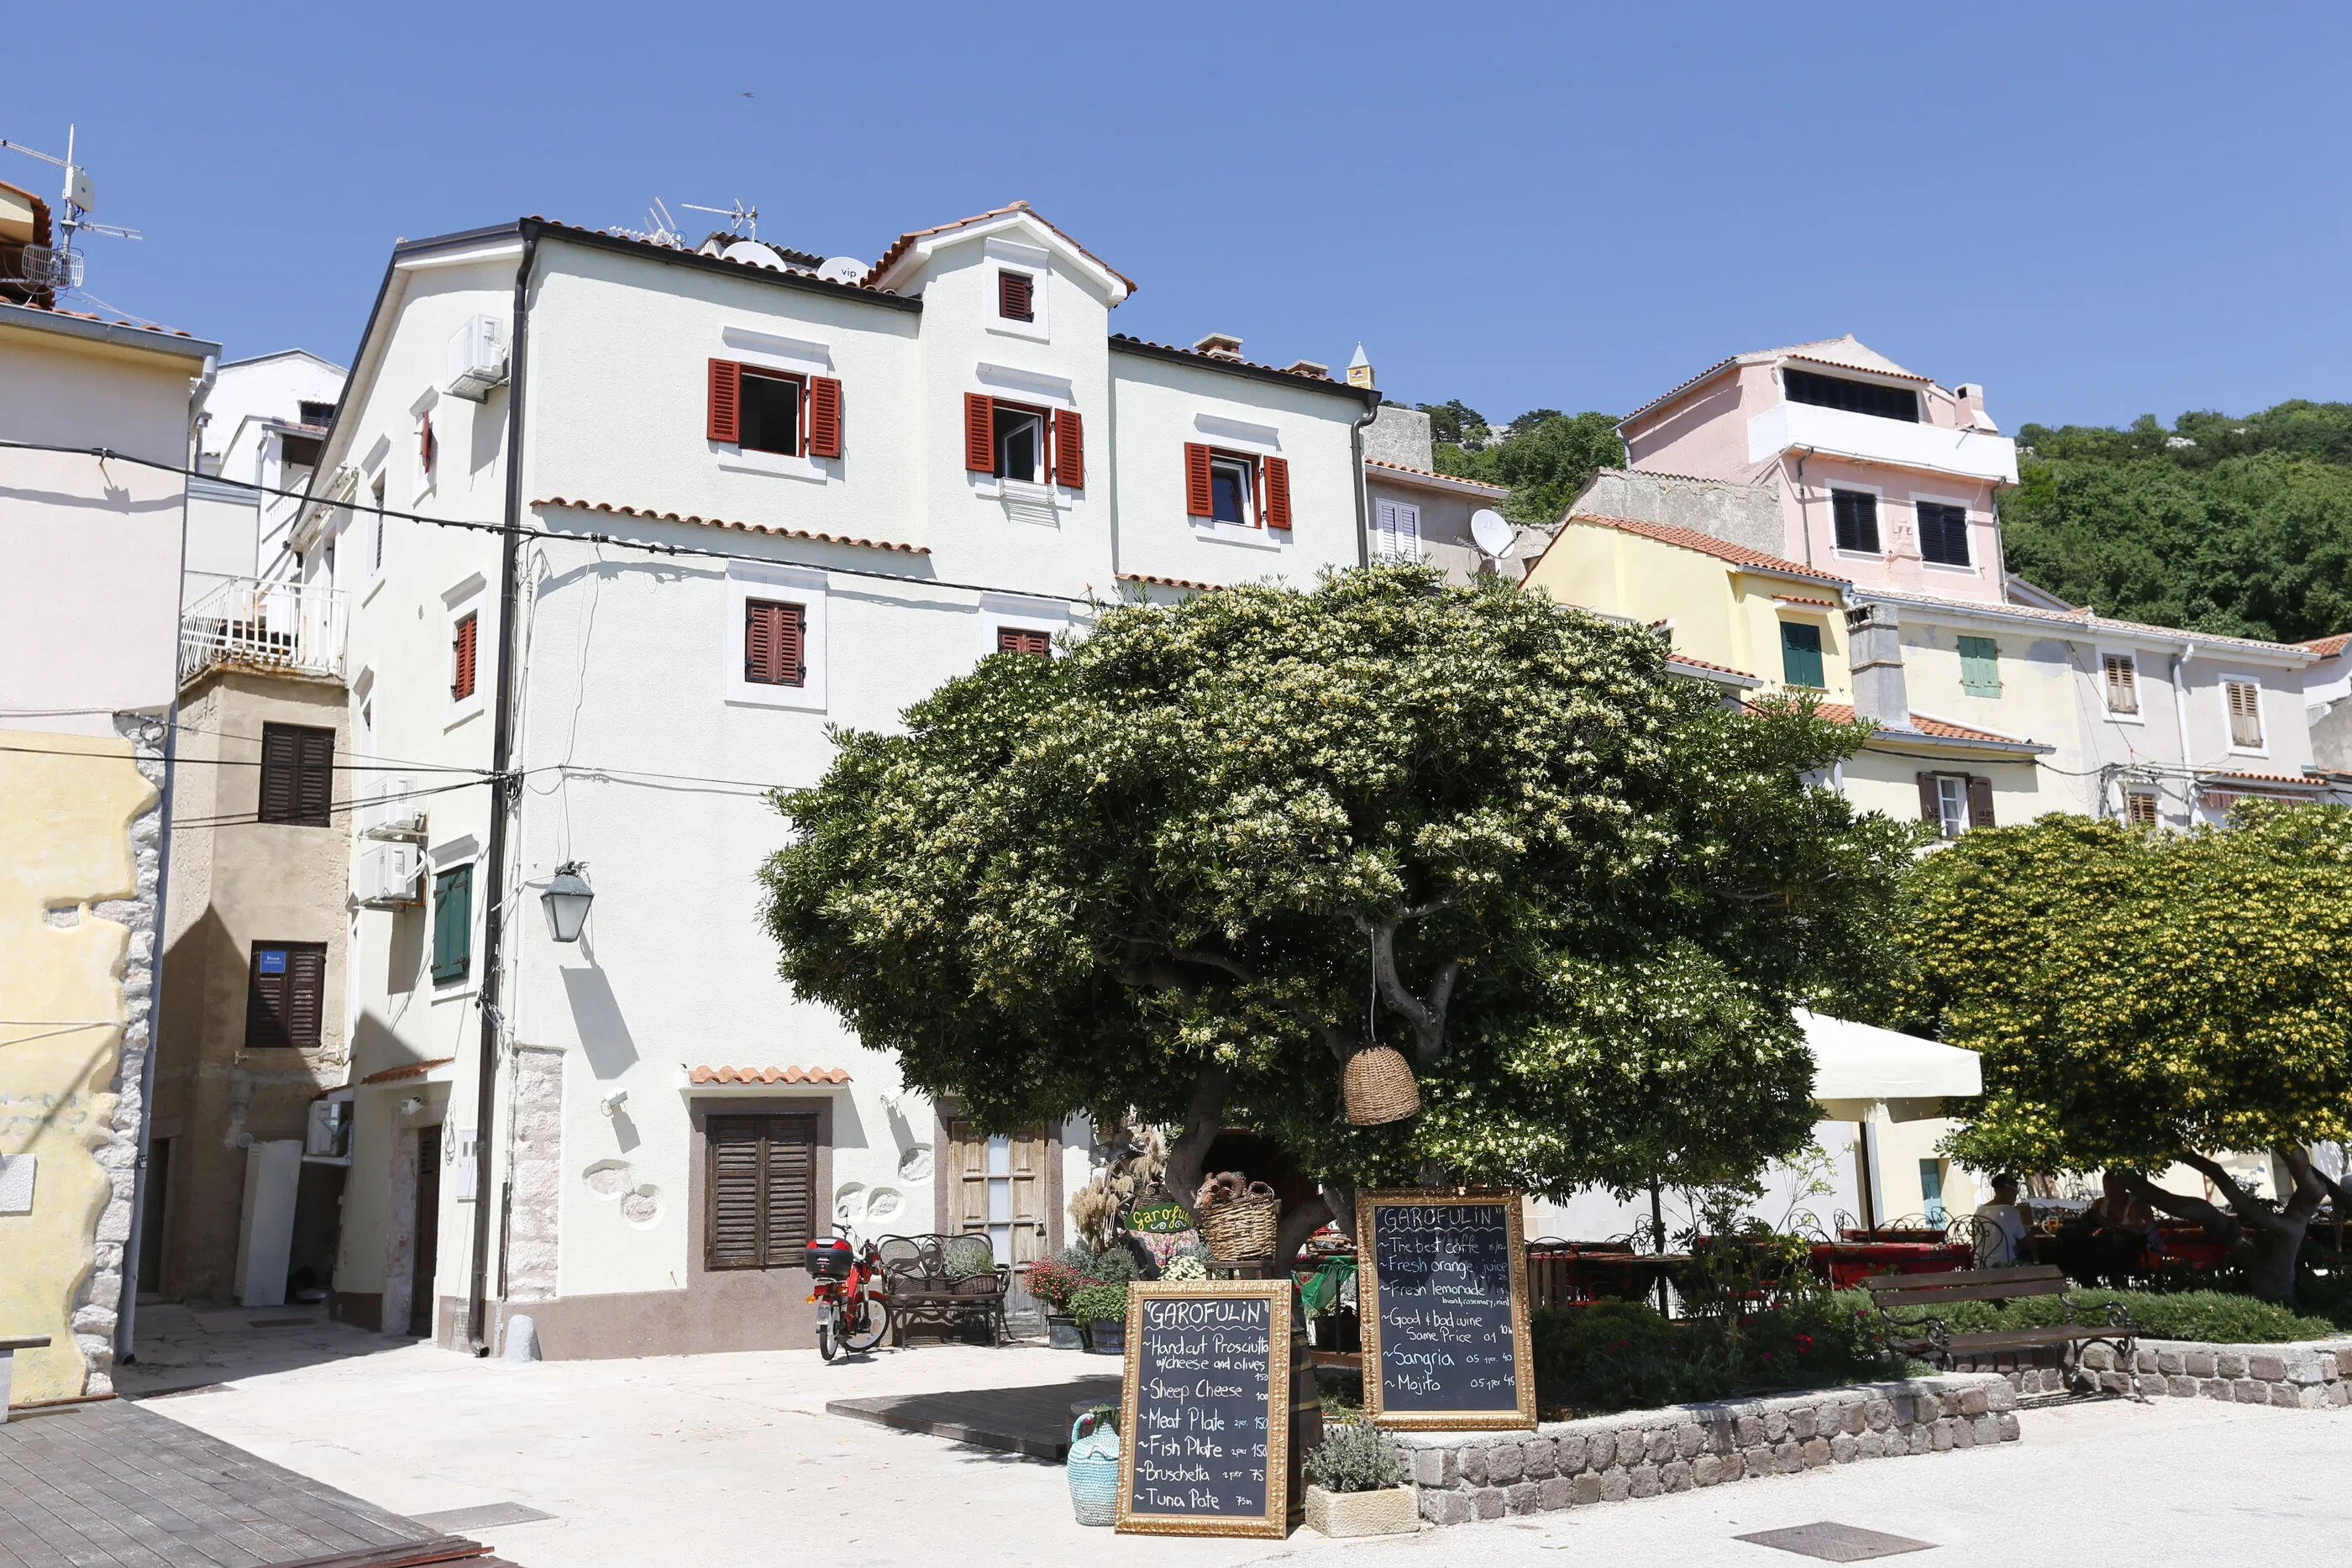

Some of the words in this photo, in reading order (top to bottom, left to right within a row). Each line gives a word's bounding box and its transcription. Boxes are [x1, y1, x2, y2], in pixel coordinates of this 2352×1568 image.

[841, 267, 857, 279] vip
[1389, 1236, 1411, 1252] The
[1416, 1236, 1441, 1253] best
[1445, 1234, 1479, 1254] coffe
[1389, 1255, 1427, 1272] Fresh
[1431, 1261, 1473, 1280] orange
[1479, 1258, 1508, 1279] juice
[1389, 1279, 1426, 1297] Fresh
[1432, 1279, 1485, 1296] lemonade
[1389, 1307, 1420, 1329] Good
[1432, 1309, 1454, 1328] bad
[1457, 1312, 1483, 1327] wine
[1406, 1326, 1439, 1340] Same
[1440, 1326, 1472, 1343] Price
[1214, 1356, 1231, 1370] and
[1234, 1358, 1265, 1371] olives
[1393, 1343, 1455, 1375] Sangria
[1149, 1377, 1189, 1405] Sheep
[1195, 1379, 1243, 1398] Cheese
[1398, 1374, 1441, 1395] Mojito
[1148, 1407, 1182, 1429] Meat
[1187, 1407, 1225, 1431] Plate
[1253, 1416, 1268, 1429] 150
[1149, 1434, 1180, 1457] Fish
[1184, 1435, 1222, 1458] Plate
[1144, 1460, 1210, 1481] Bruschetta
[1249, 1469, 1265, 1481] 75
[1146, 1488, 1185, 1508] Tuna
[1189, 1488, 1221, 1510] Pate
